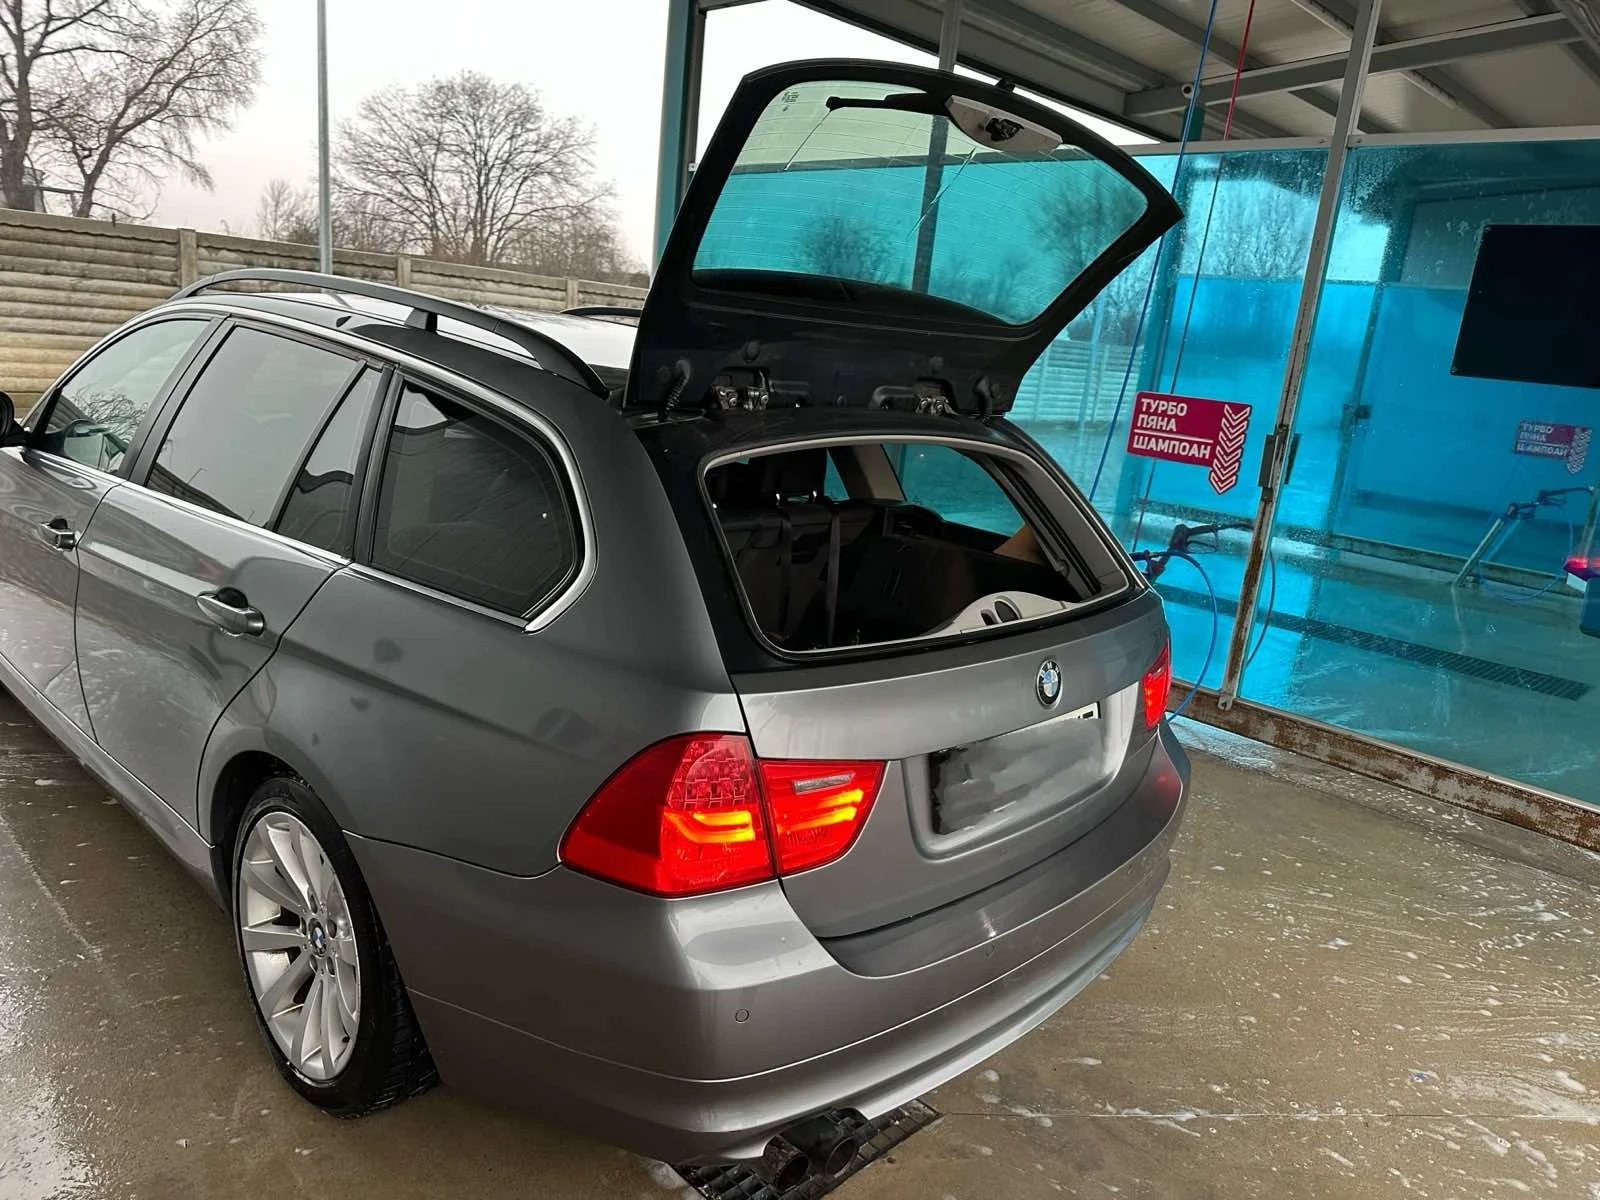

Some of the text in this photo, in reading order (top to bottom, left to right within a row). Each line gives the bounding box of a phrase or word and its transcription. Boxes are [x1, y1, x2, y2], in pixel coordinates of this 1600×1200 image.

[1141, 398, 1187, 416] ТУРБО
[1137, 414, 1176, 432] ПЯНА
[1133, 435, 1211, 459] ШАМПОАН
